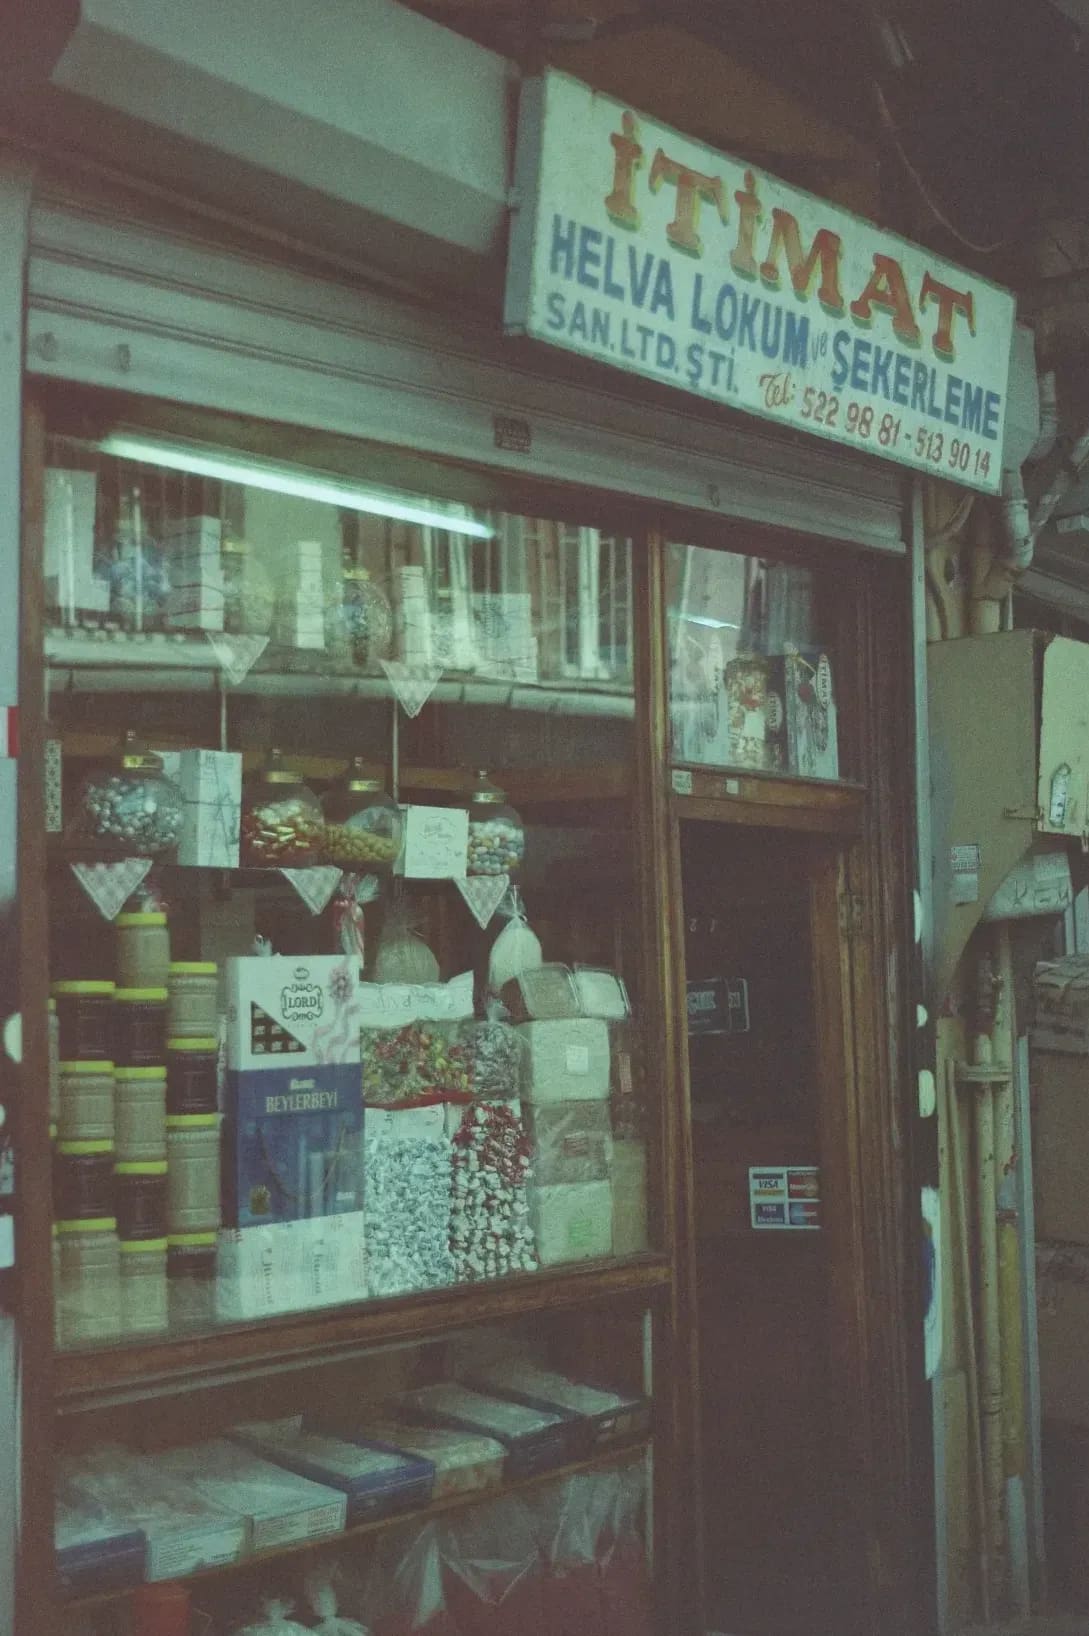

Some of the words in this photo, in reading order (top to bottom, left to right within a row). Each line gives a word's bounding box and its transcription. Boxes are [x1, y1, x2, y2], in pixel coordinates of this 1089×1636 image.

[604, 110, 976, 363] İTİMAT
[550, 213, 675, 322] HELVA
[691, 272, 810, 369] LOKUM
[811, 331, 829, 362] ve
[830, 329, 1001, 441] ŞEKERLEME
[759, 371, 797, 408] Tel:
[801, 386, 840, 428] 522
[844, 402, 874, 439] 98
[914, 426, 945, 463] 513
[948, 438, 972, 472] 90
[974, 447, 991, 479] 14
[288, 996, 317, 1009] LORD
[758, 1179, 779, 1189] VISA
